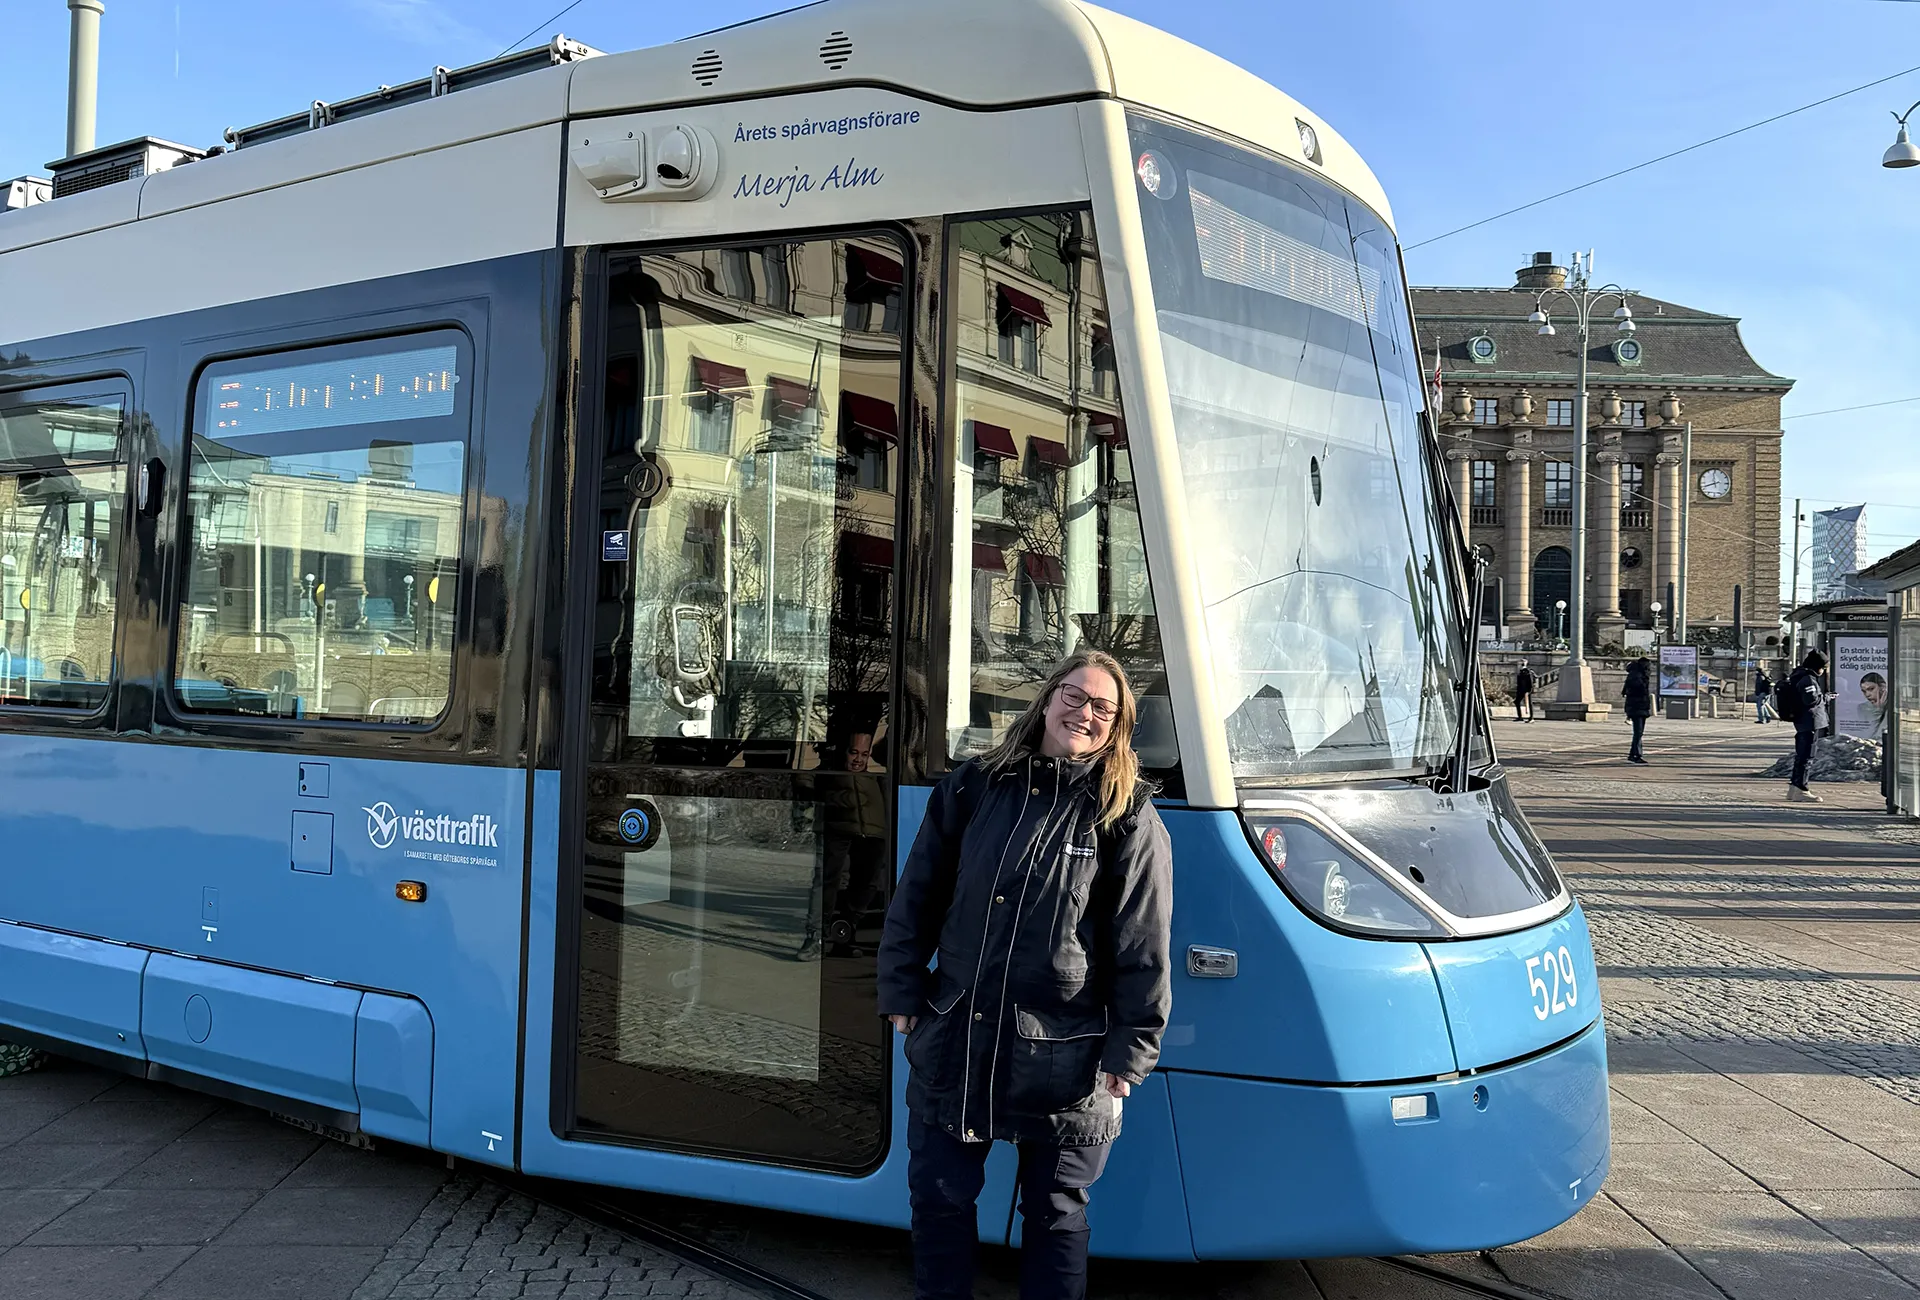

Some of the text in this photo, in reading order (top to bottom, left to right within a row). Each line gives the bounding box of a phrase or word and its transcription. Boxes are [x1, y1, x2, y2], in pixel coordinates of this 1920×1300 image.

[733, 110, 921, 143] Årets spårvagnsförare
[733, 157, 884, 208] Merja Alm
[401, 809, 498, 847] västtrafik
[407, 850, 432, 860] SAMARBETE
[432, 852, 443, 861] MED
[443, 853, 470, 865] GÖTEBORGS
[470, 856, 498, 867] SPÅRVÄGAR
[1525, 945, 1578, 1021] 529
